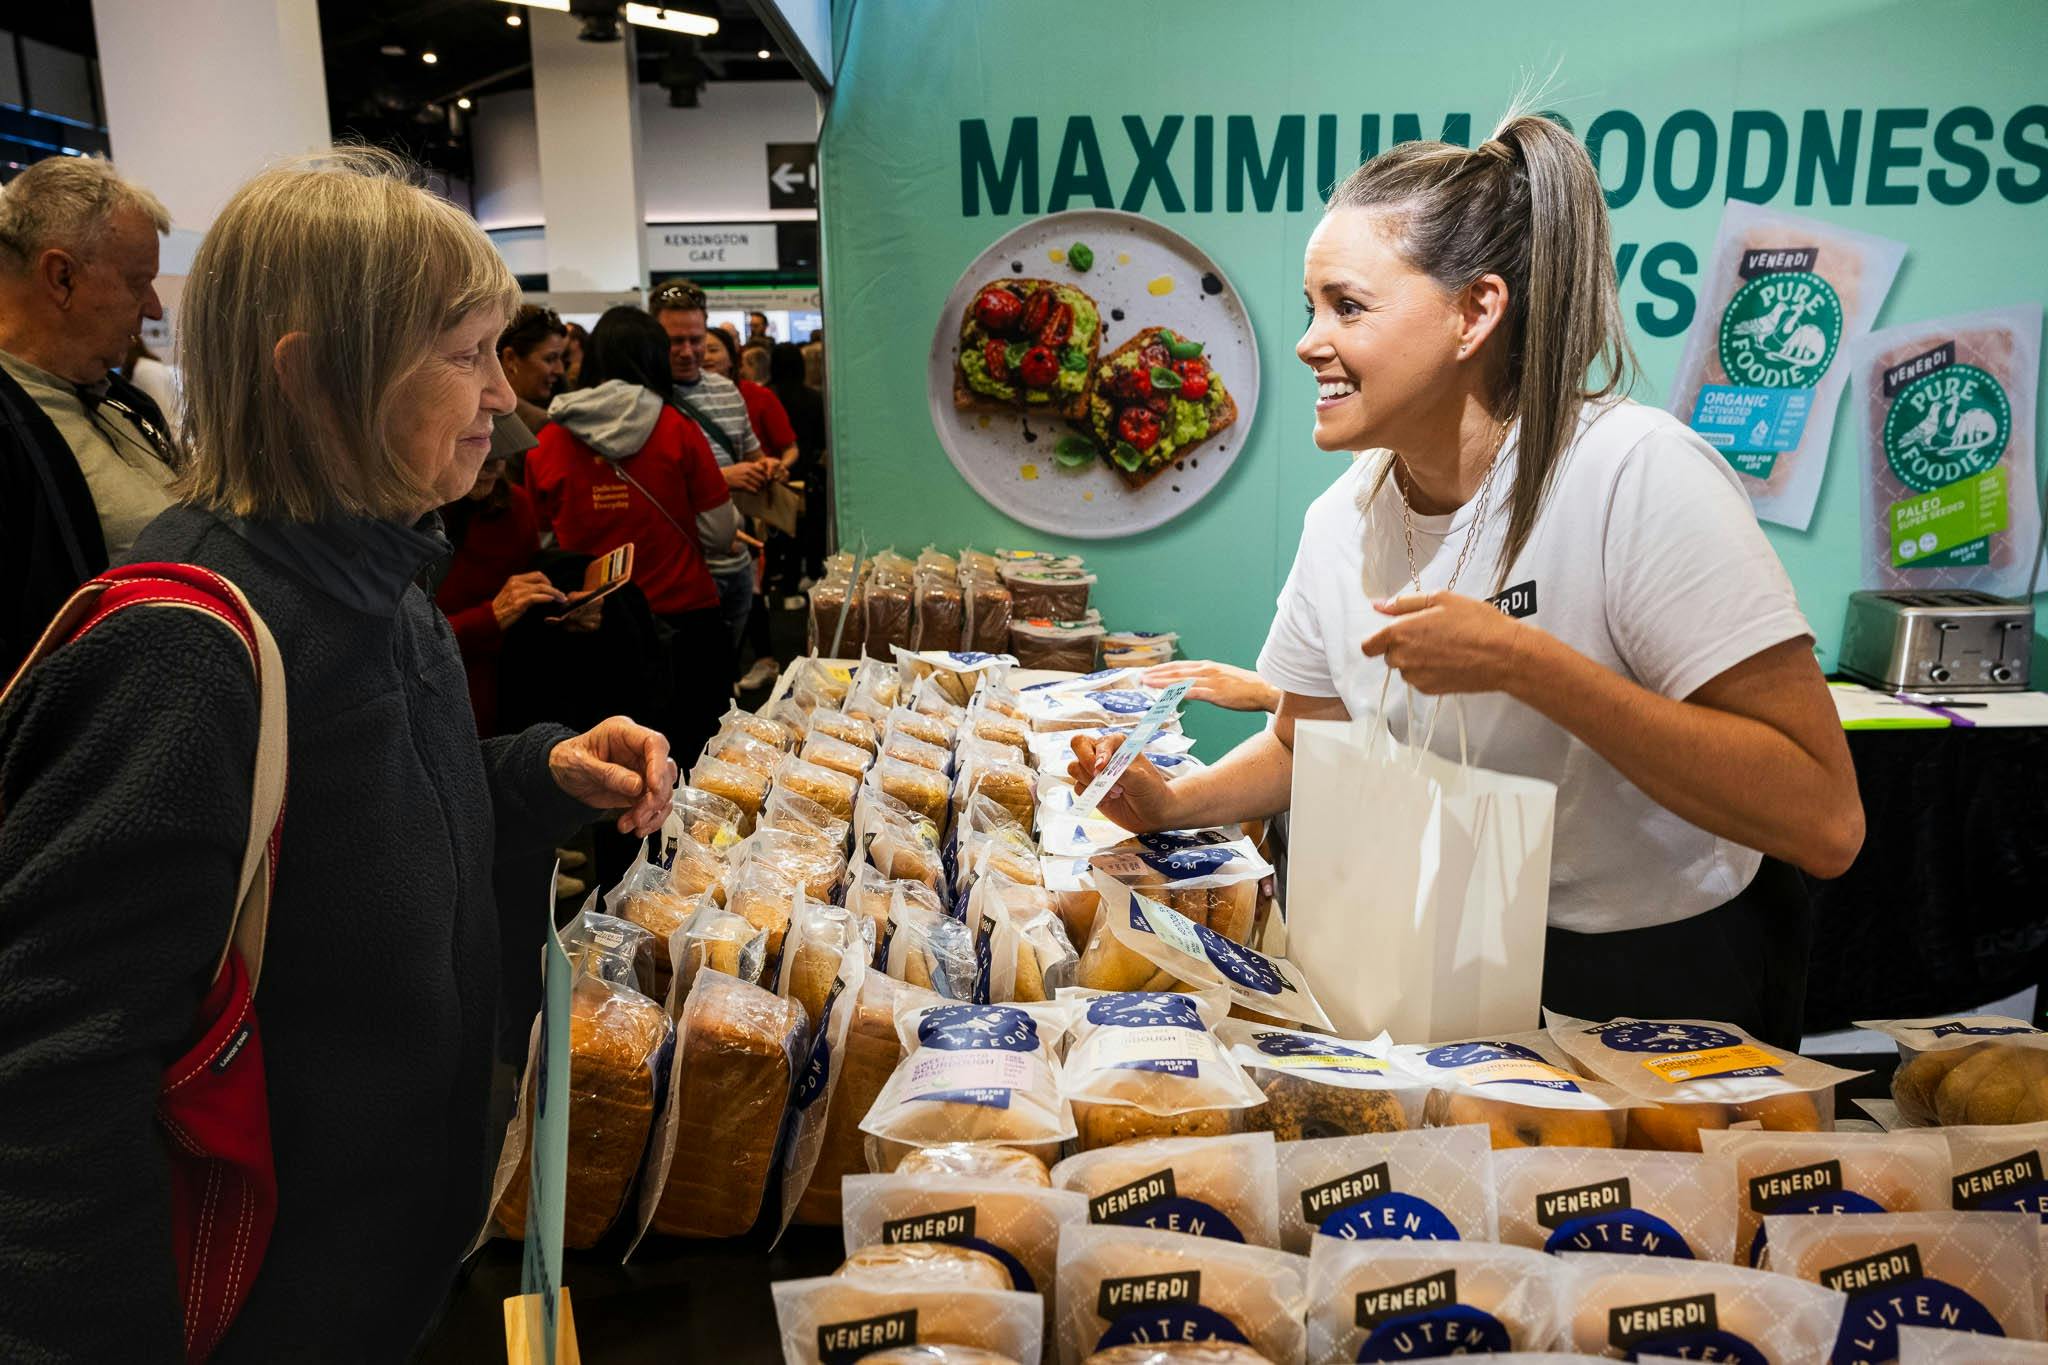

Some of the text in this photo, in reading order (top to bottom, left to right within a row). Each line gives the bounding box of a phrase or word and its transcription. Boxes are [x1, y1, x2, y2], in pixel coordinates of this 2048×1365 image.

[1534, 104, 2048, 210] OODNESS
[664, 234, 749, 246] KENSINGTON
[688, 248, 726, 262] CAFÉ
[1749, 252, 1809, 270] VENERDI
[1758, 281, 1826, 316] PURE
[1732, 337, 1806, 387] FOODIE
[1889, 350, 1947, 386] VENERDI
[1701, 405, 1753, 416] ACTIVATED
[1704, 391, 1770, 407] ORGANIC
[1910, 376, 1979, 412] PURE
[1902, 445, 1985, 482] FOODIE
[1897, 496, 1941, 521] PALEO
[937, 1019, 1030, 1047] FREEDOM
[965, 1089, 987, 1097] FOOD
[1309, 1174, 1380, 1212] VENERDI
[1758, 1168, 1831, 1201] VENERDI
[1958, 1162, 2032, 1200] VENERDI
[1097, 1178, 1166, 1220] VENERDI
[1544, 1187, 1621, 1217] VENERDI
[891, 1216, 965, 1243] VENERDI
[1830, 1255, 1911, 1292] VENERDI
[1109, 1279, 1189, 1305] VENERDI
[1364, 1281, 1448, 1316] VENERDI
[824, 1319, 906, 1353] VENERDI
[1619, 1304, 1707, 1336] VENERDI
